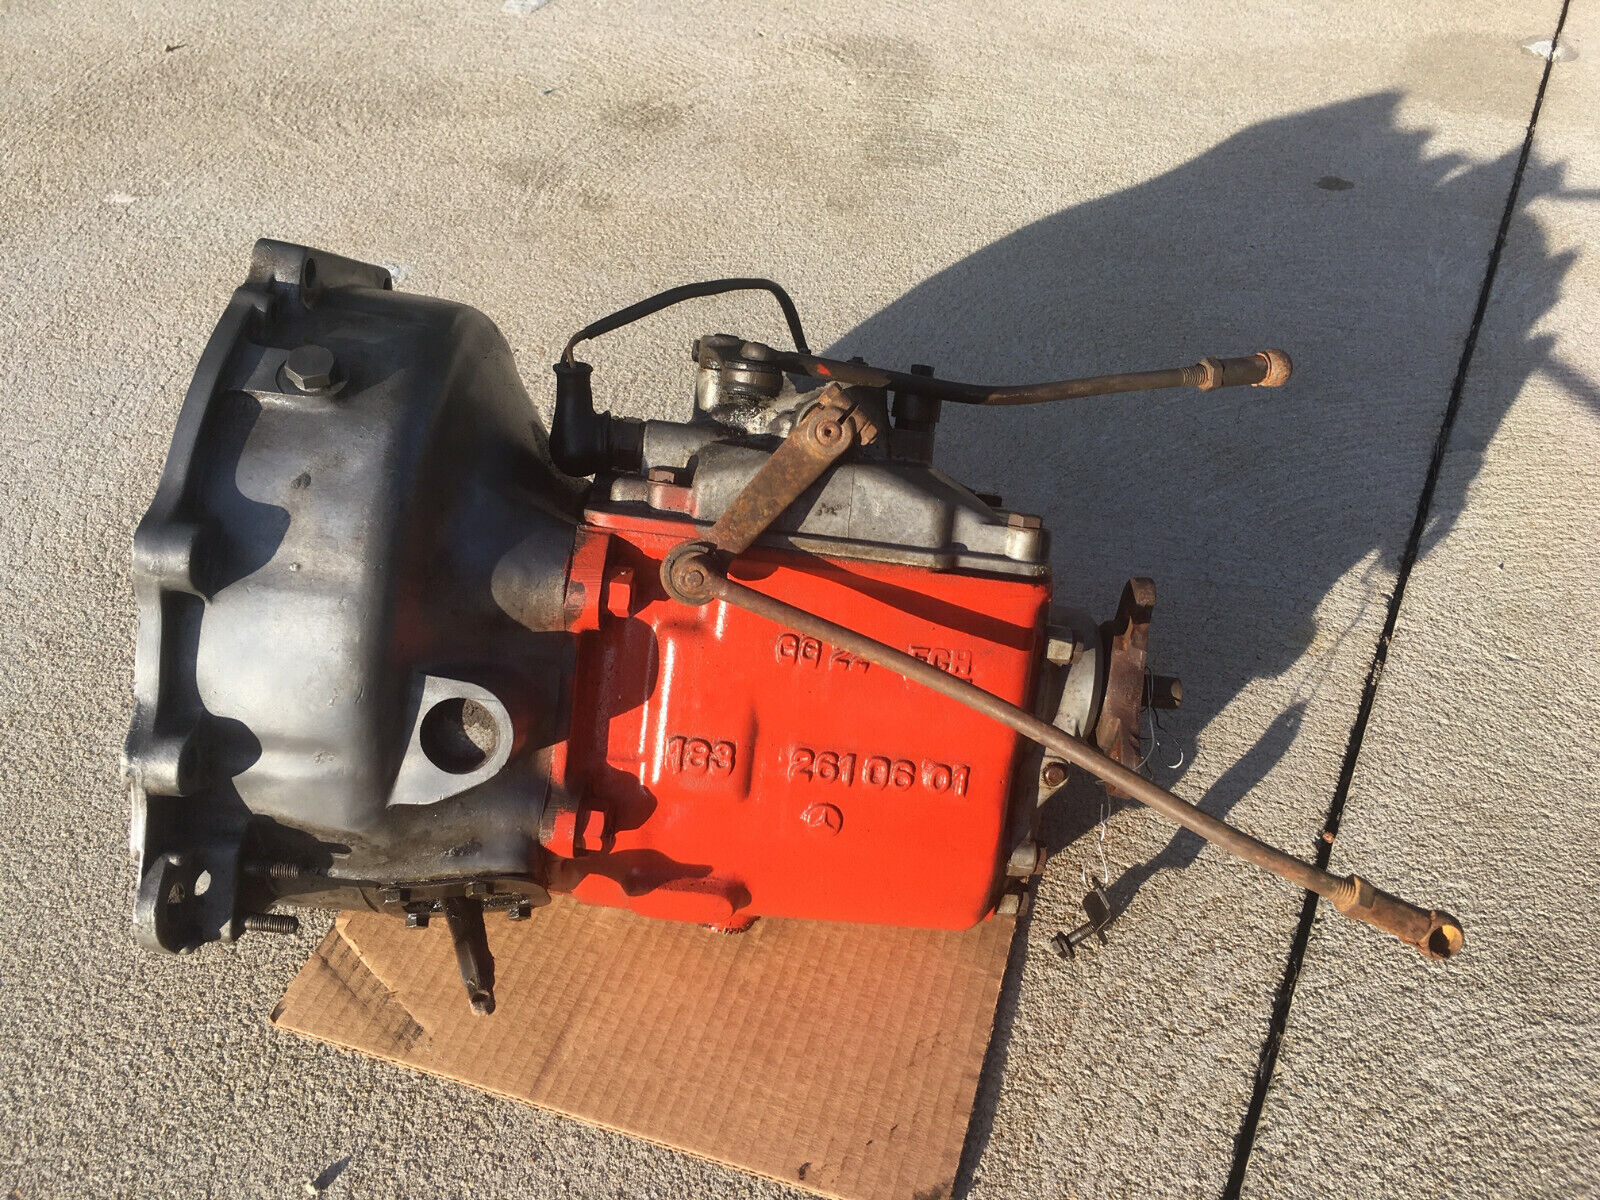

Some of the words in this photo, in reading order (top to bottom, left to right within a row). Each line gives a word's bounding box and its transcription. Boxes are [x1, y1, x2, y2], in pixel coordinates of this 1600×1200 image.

[664, 735, 737, 776] 183
[786, 746, 857, 787] 261
[862, 754, 917, 791] 06
[921, 758, 972, 798] 01
